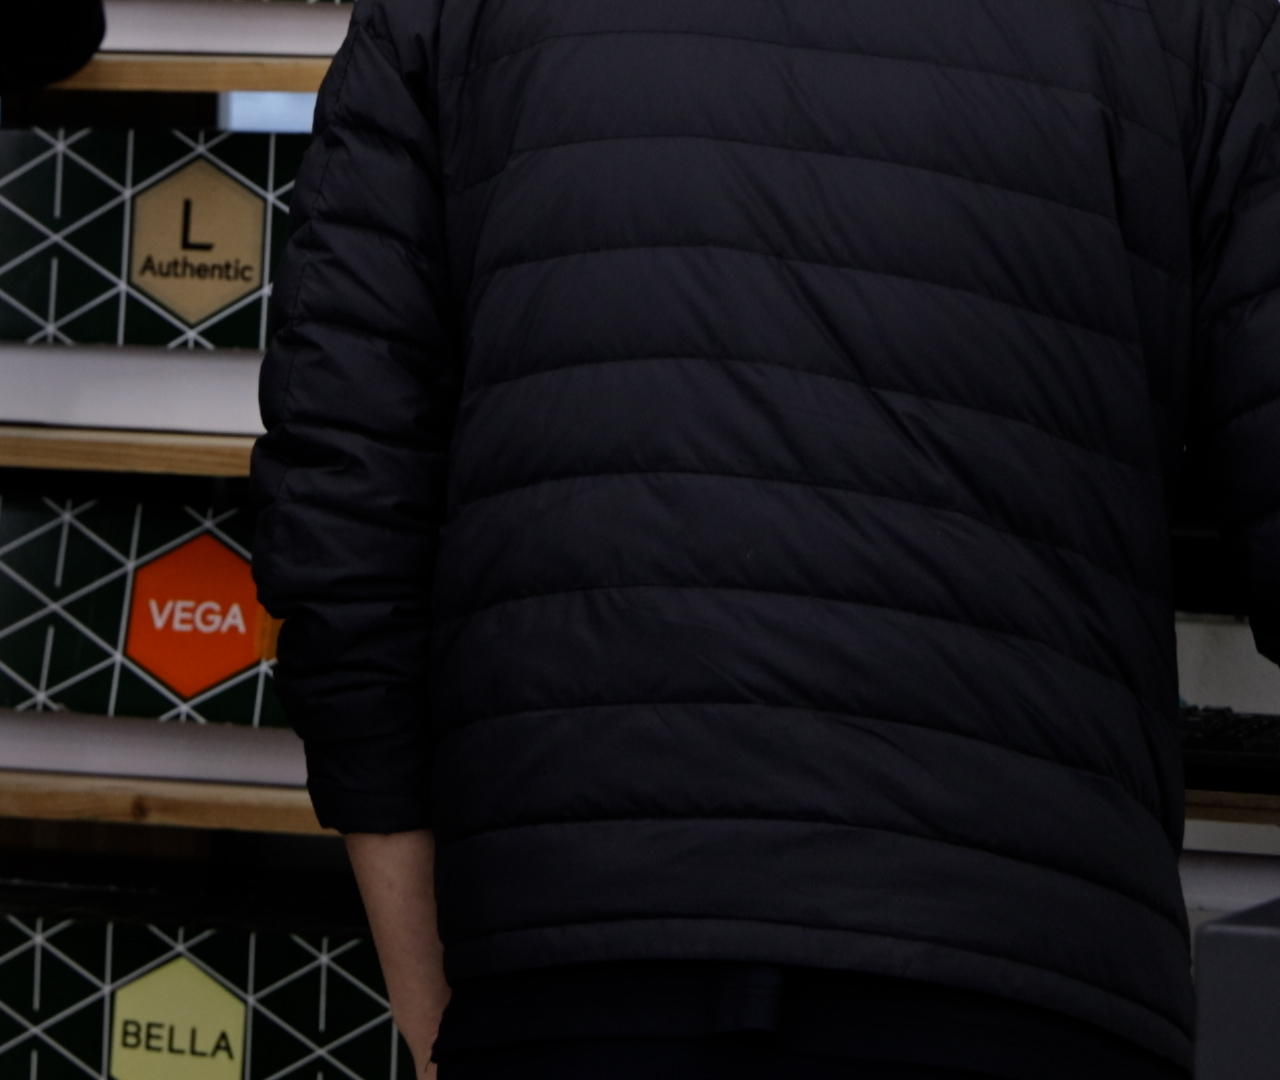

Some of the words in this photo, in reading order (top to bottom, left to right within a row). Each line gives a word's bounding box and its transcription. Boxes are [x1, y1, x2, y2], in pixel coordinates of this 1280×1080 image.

[179, 197, 214, 253] L
[138, 254, 253, 283] Authentic
[149, 598, 247, 635] VEGA
[121, 1018, 235, 1061] BELLA
